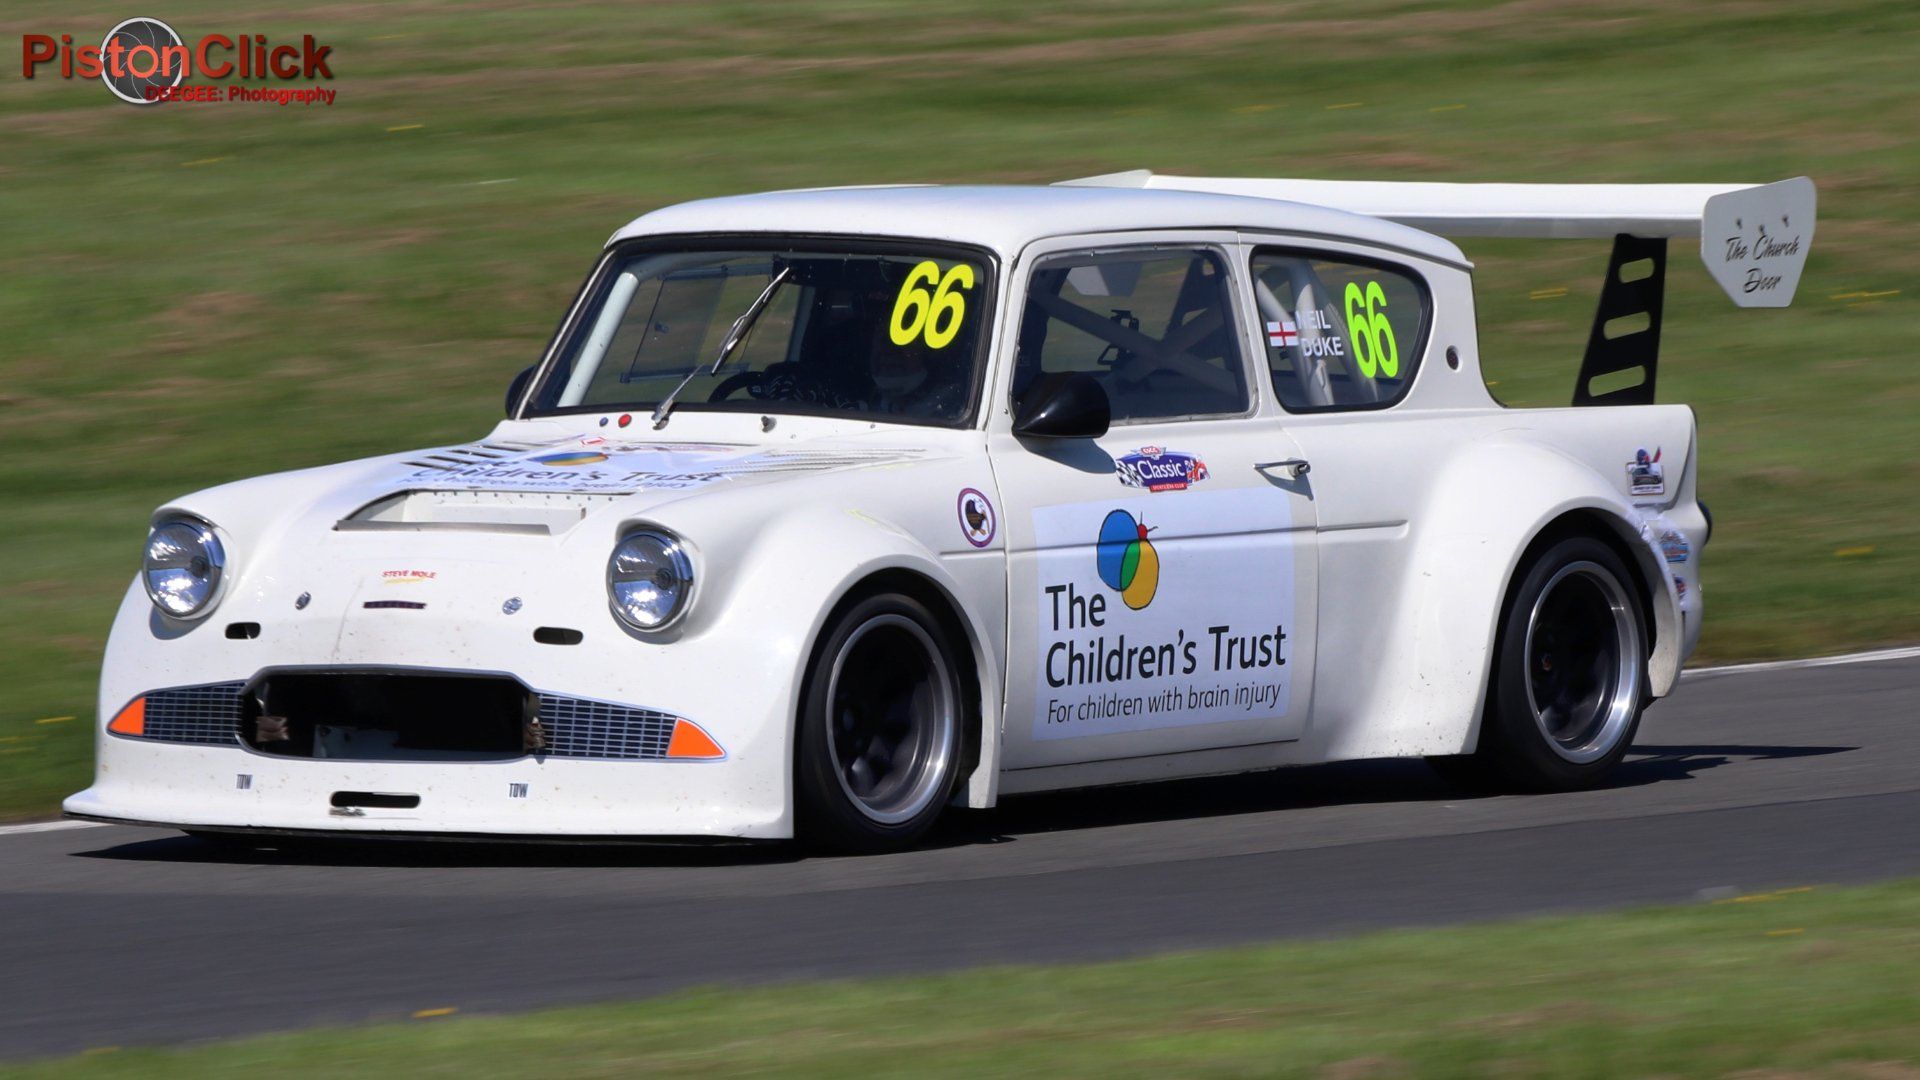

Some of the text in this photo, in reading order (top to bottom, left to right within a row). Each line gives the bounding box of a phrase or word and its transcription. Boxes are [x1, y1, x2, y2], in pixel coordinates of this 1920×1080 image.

[1725, 234, 1800, 262] The Church
[890, 260, 974, 349] 66
[1295, 309, 1332, 330] NEIL
[1345, 281, 1399, 379] 66
[1301, 336, 1344, 357] DUKE
[619, 470, 723, 482] Trust
[1137, 459, 1186, 479] Classic
[1045, 582, 1106, 631] The
[1045, 625, 1286, 688] Children's Trust
[1047, 682, 1282, 724] For children with brain injury
[509, 783, 528, 798] TOW
